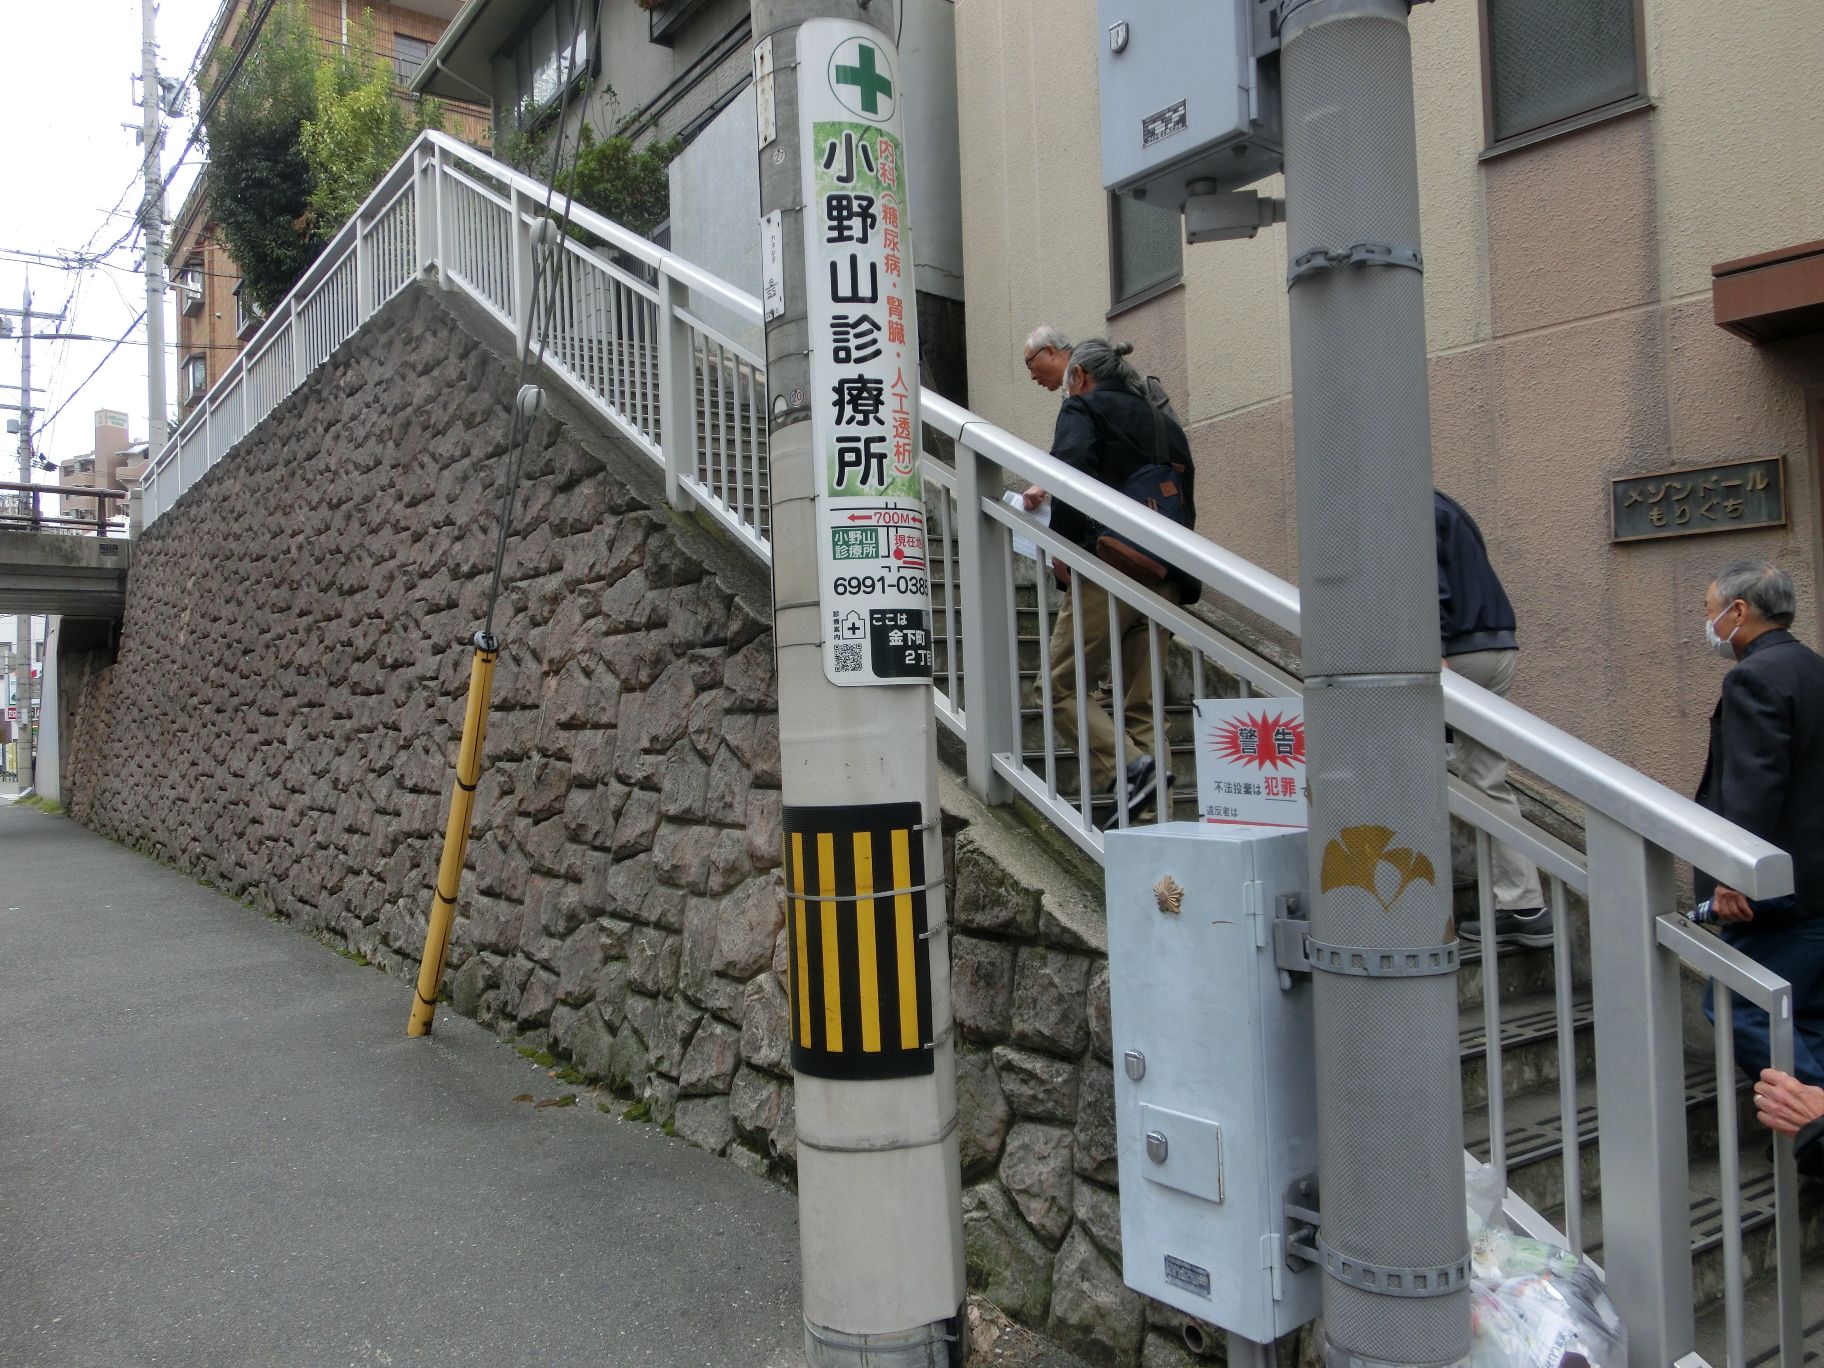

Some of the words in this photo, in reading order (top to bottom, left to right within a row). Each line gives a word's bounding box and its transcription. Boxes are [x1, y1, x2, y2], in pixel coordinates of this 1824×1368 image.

[823, 131, 888, 488] 小野山診療所
[1624, 470, 1769, 508] メゾンドール
[873, 511, 910, 525] 700M
[1650, 498, 1744, 527] もりぐち
[834, 530, 876, 545] 小野山
[895, 534, 923, 549] 現在地
[834, 544, 877, 558] 診療所
[872, 612, 908, 626] ここは
[888, 629, 926, 646] 金下町
[905, 649, 932, 666] 2丁目
[1238, 727, 1295, 756] 警告
[1206, 805, 1239, 817] 違反者は
